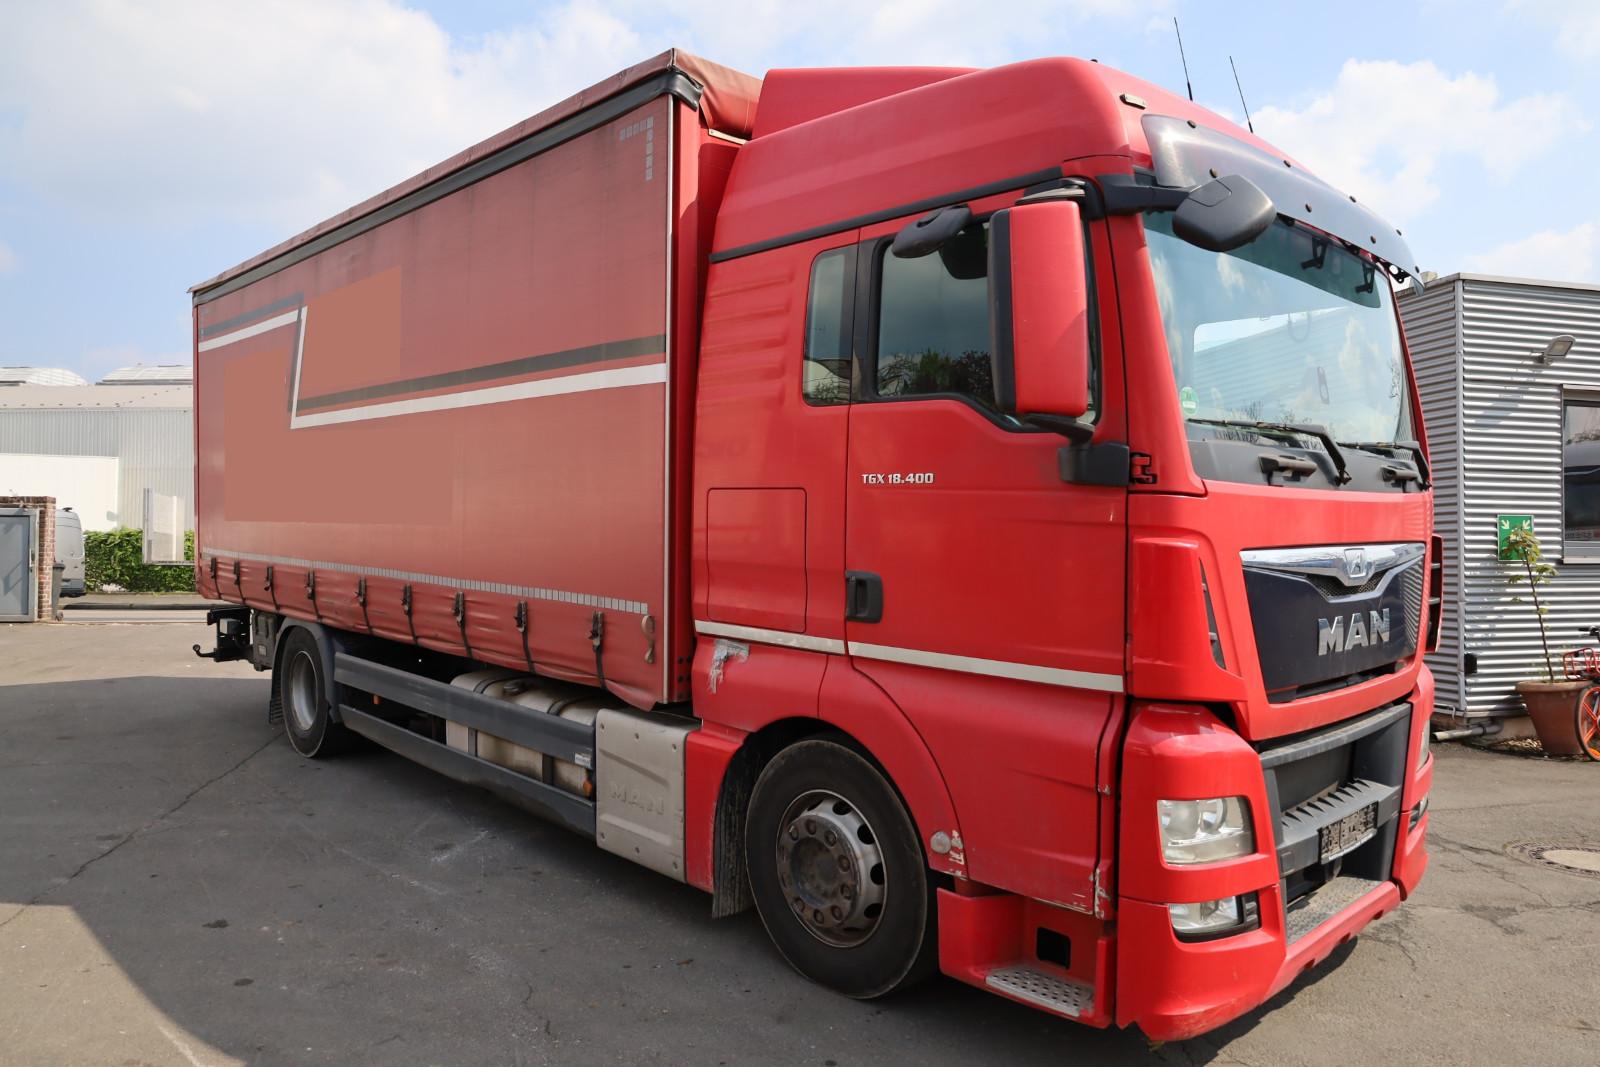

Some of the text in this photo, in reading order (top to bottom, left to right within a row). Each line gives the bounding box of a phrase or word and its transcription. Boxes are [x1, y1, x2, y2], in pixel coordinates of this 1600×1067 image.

[862, 472, 934, 484] TGX 18.400
[1317, 607, 1391, 657] MAN
